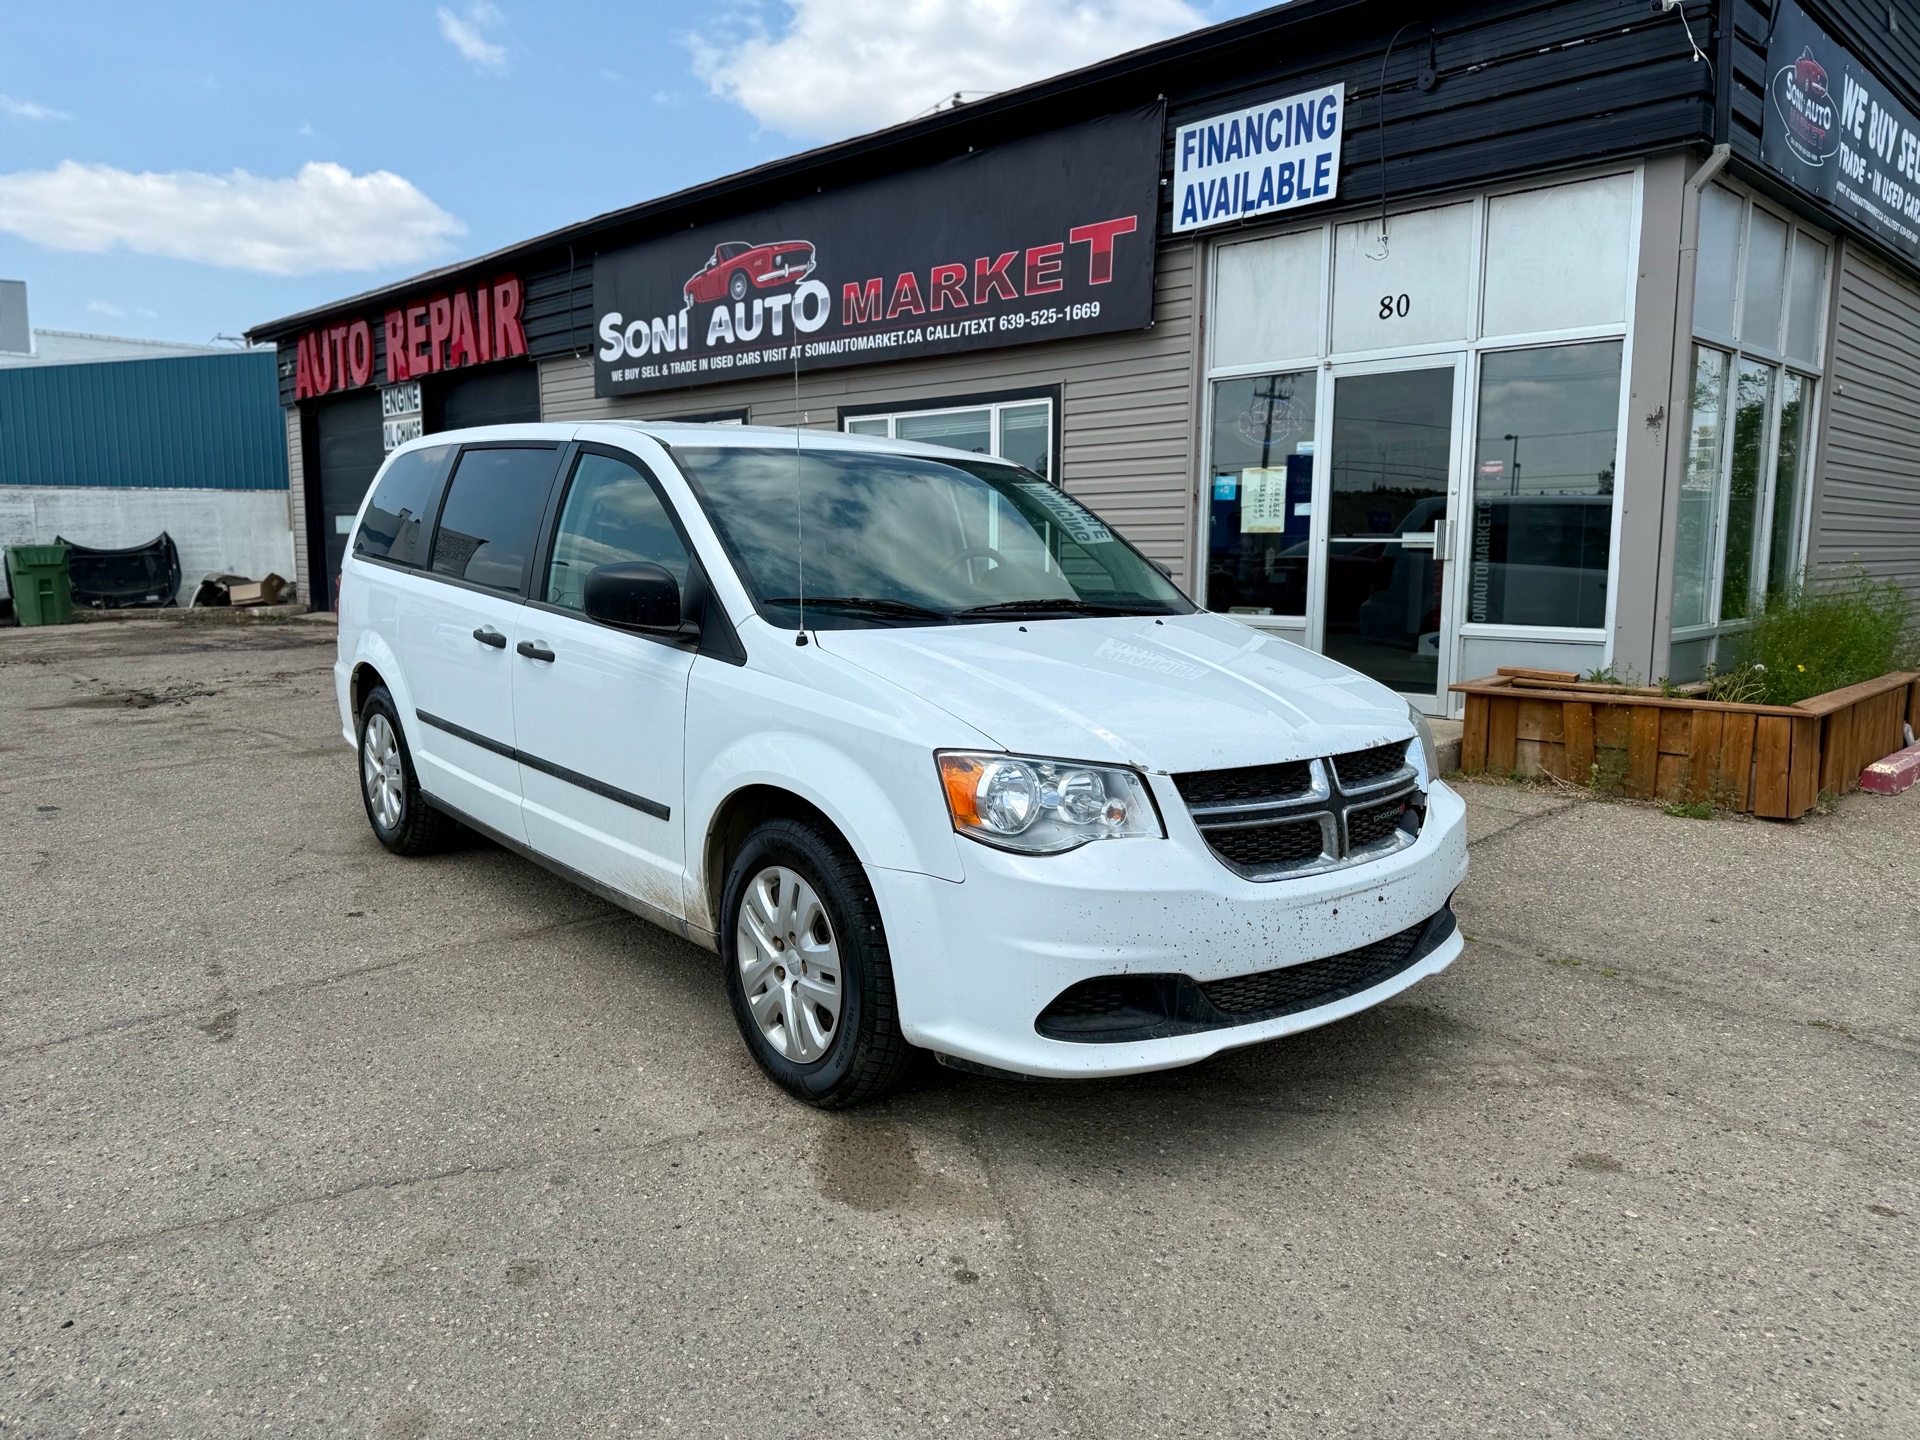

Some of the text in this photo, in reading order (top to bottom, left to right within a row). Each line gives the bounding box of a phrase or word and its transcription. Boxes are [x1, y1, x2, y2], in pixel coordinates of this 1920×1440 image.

[1182, 94, 1337, 172] FINANCING
[1786, 71, 1831, 130] SONI AUTO
[1841, 72, 1868, 140] WE
[1868, 100, 1898, 164] BUY
[1180, 152, 1333, 225] AVAILABLE
[1839, 141, 1867, 184] TRADE
[1872, 169, 1882, 197] IN
[1882, 176, 1904, 211] USED
[599, 215, 1137, 362] SONI AUTO MARKET
[1379, 293, 1410, 319] 80
[295, 272, 528, 399] AUTO REPAIR
[611, 301, 1101, 382] WE BUY SELL & TRADE IN USED CARS VISIT AT SONIAUTOMARKET.CA CALL/TEXT 639-525-1669
[384, 384, 419, 414] ENGINE
[385, 423, 396, 447] OIL
[1472, 495, 1492, 622] ONIAUTOMARKET.C
[1373, 806, 1401, 823] DODGE
